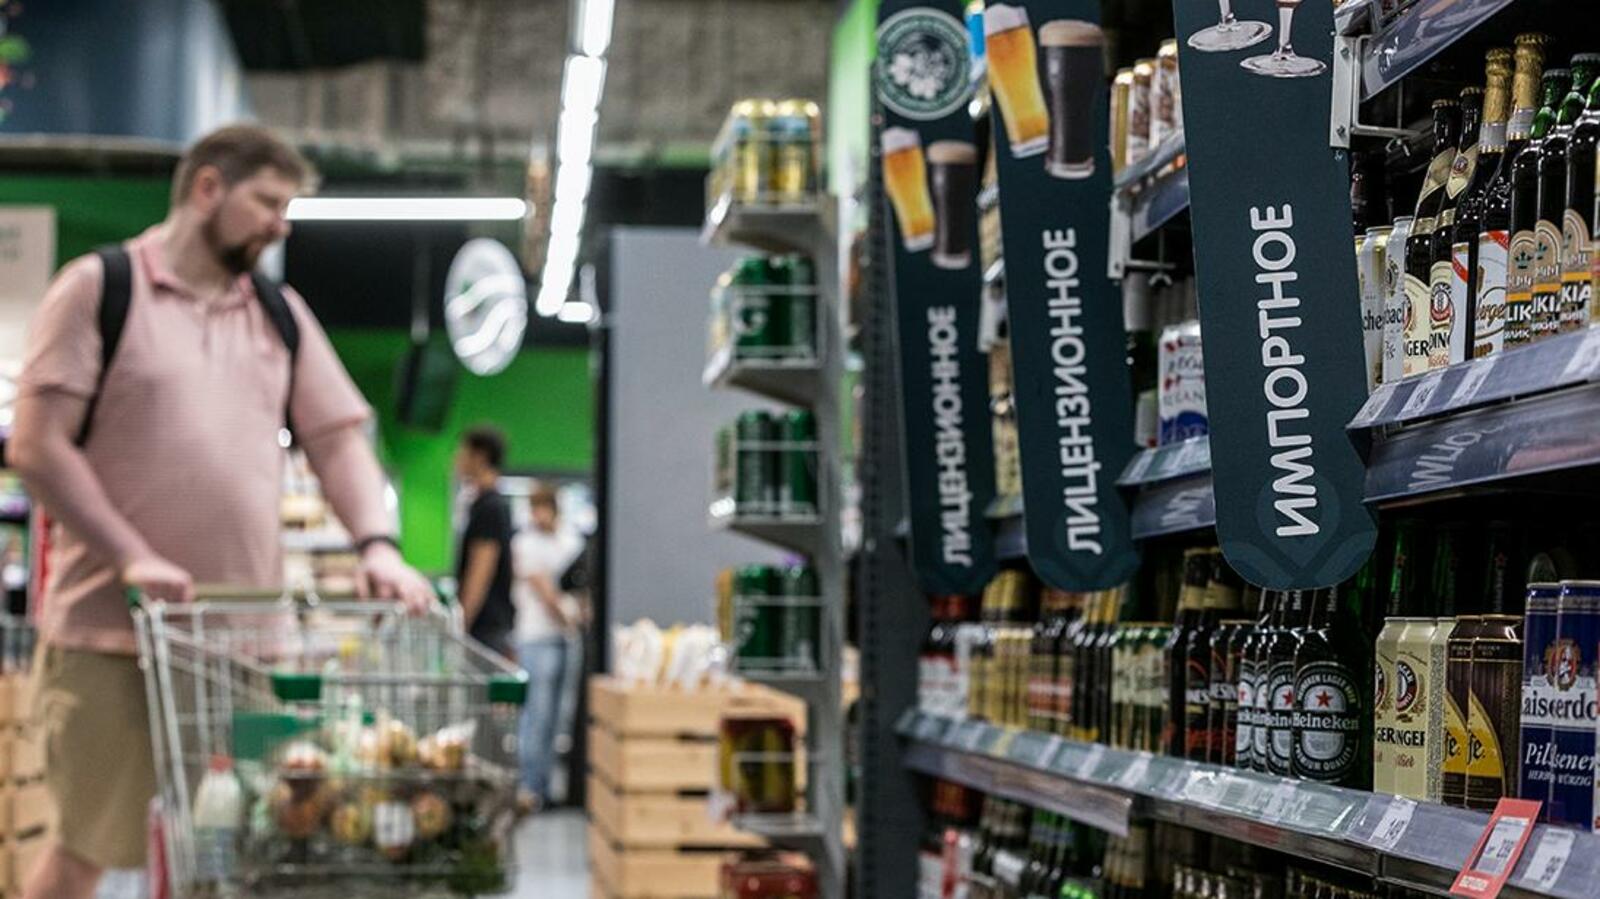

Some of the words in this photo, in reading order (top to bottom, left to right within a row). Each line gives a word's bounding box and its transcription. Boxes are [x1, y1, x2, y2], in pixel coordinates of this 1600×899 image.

[928, 306, 973, 567] ЛИЦЕНЗИОННОЕ
[1043, 228, 1102, 555] ЛИЦЕНЗИОННОЕ
[1250, 203, 1320, 537] ИМПОРТНОЕ
[1293, 712, 1359, 730] Heineken
